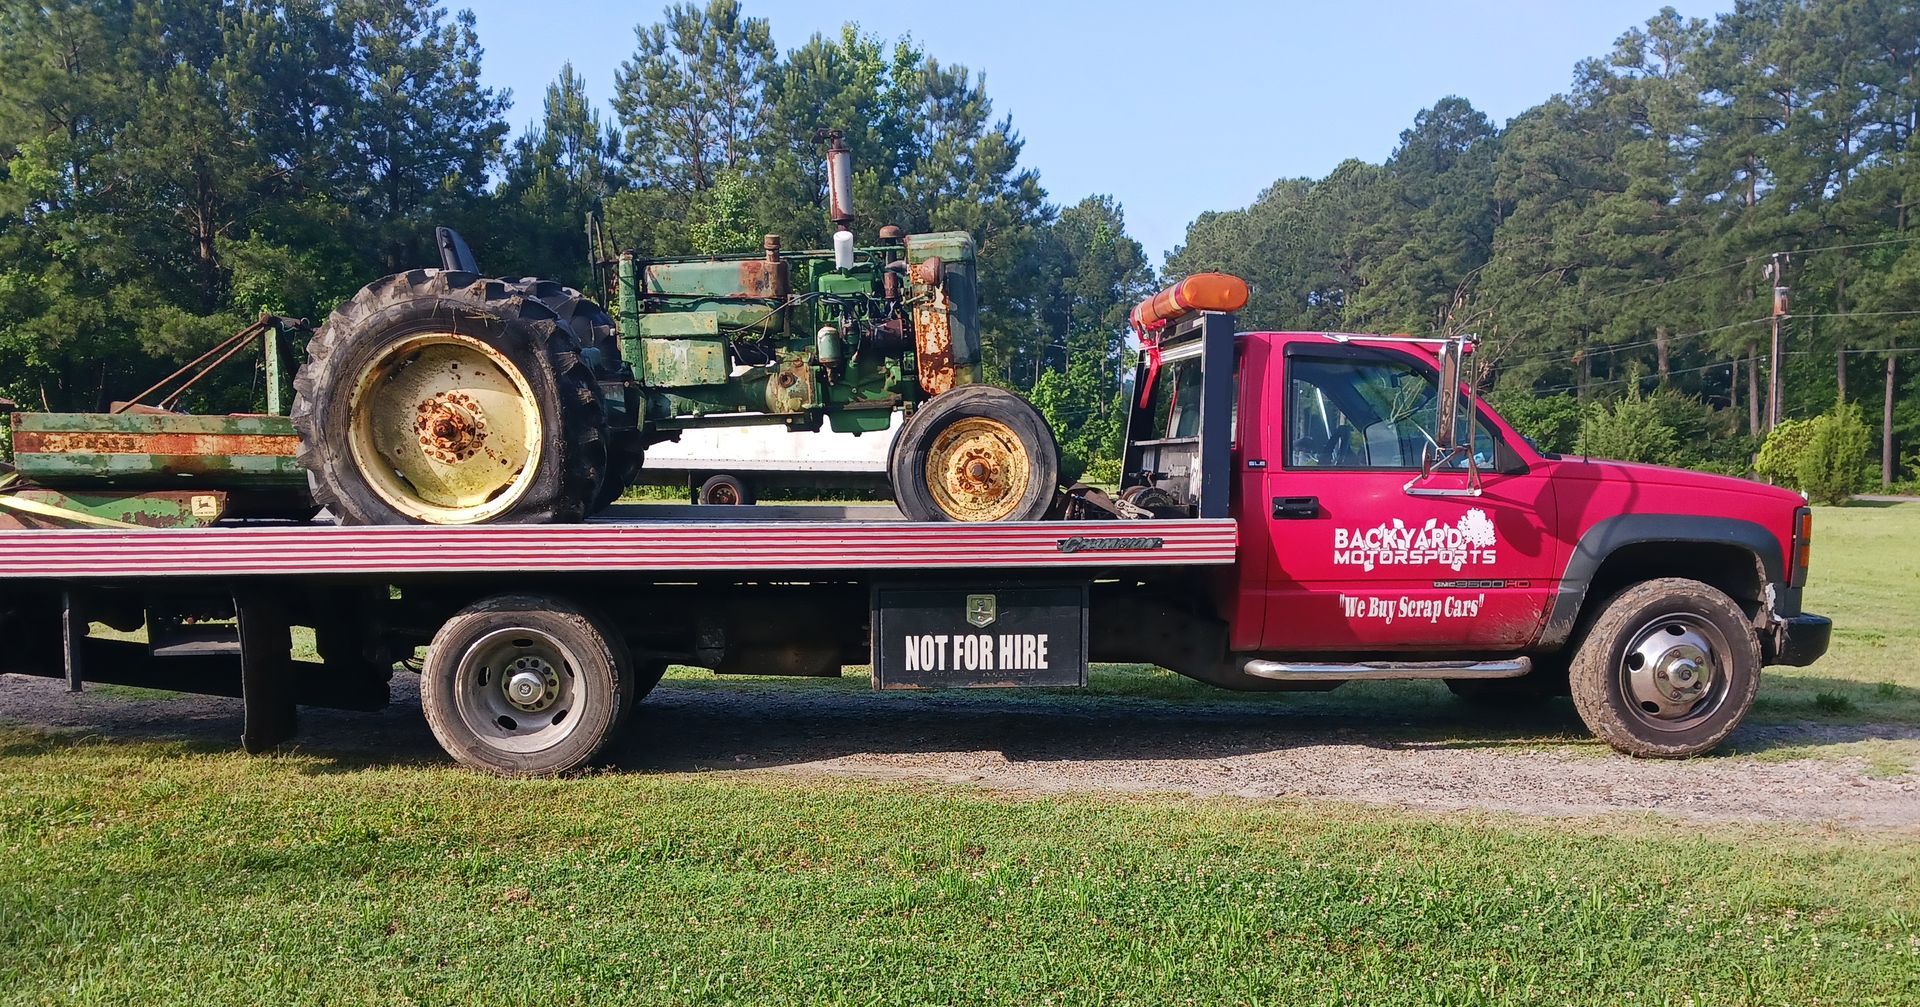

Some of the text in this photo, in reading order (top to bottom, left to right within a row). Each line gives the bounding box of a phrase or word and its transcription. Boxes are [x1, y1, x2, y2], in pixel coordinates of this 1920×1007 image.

[1333, 527, 1464, 549] BACKYARD
[1333, 550, 1496, 565] MOTORSPORTS
[1339, 593, 1485, 625] "We Buy Scrap Cars"
[905, 633, 1049, 672] NOT FOR HIRE
